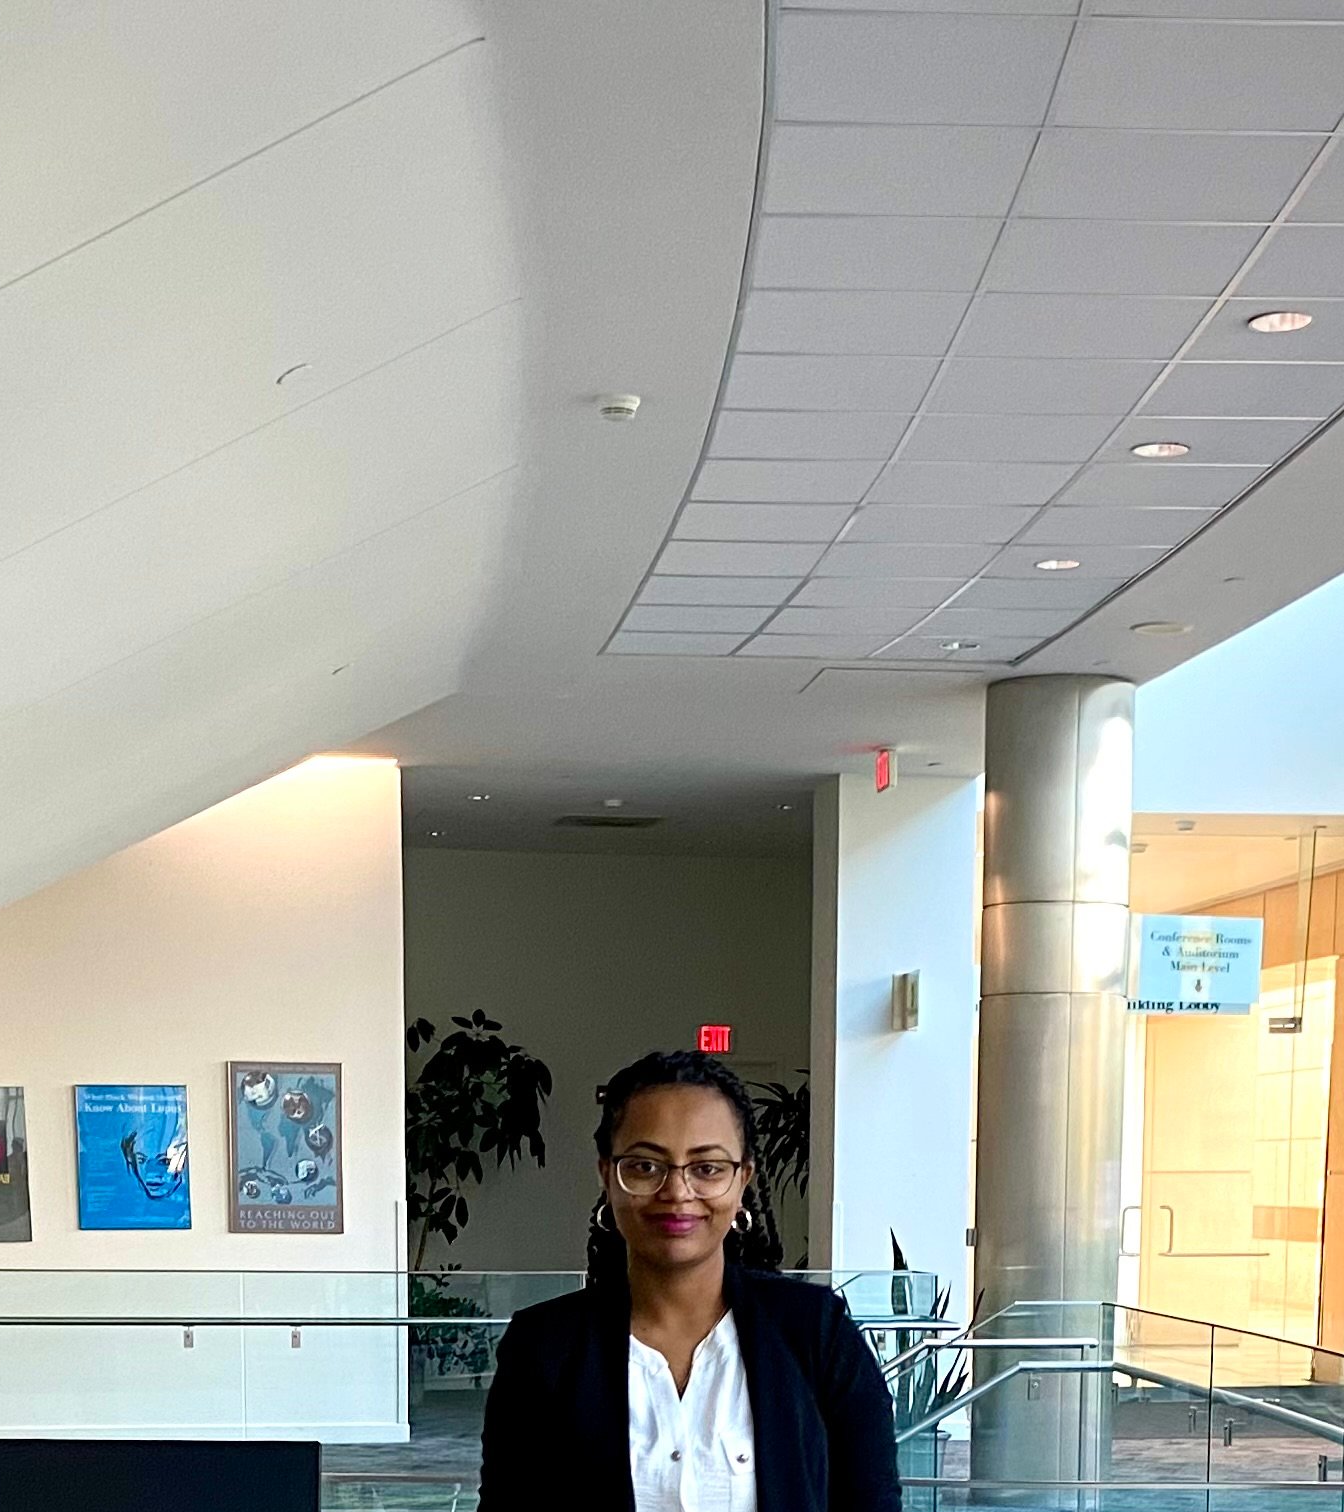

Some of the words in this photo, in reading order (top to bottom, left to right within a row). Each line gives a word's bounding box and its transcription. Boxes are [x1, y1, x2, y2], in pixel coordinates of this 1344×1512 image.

[701, 1026, 730, 1051] EXIT
[84, 1103, 113, 1112] Know
[117, 1102, 147, 1113] About
[239, 1209, 305, 1220] REACHING
[310, 1210, 336, 1220] OUT
[239, 1219, 256, 1230] TO
[262, 1220, 285, 1230] THE
[290, 1220, 336, 1230] WORLD
